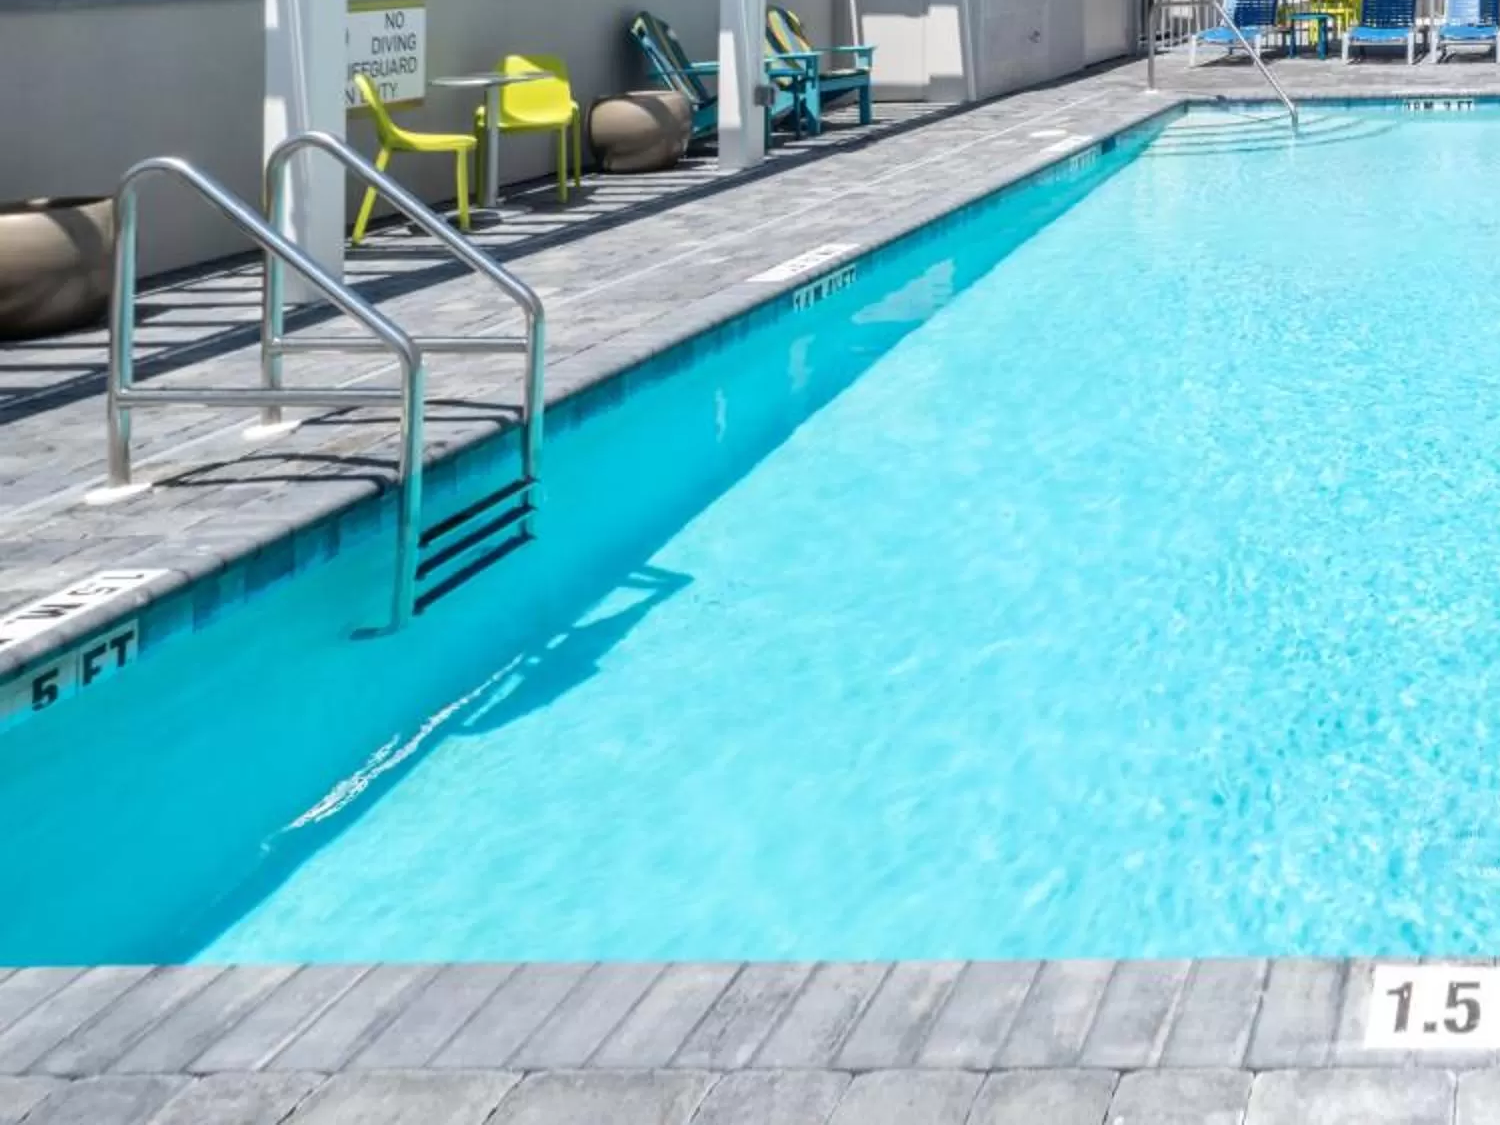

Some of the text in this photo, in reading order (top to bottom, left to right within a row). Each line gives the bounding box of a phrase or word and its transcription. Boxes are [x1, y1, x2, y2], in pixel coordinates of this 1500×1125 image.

[384, 10, 405, 30] NO
[371, 32, 417, 55] DIVING
[345, 86, 355, 105] N
[31, 629, 135, 712] 5 FT
[1386, 980, 1481, 1034] 1.5
